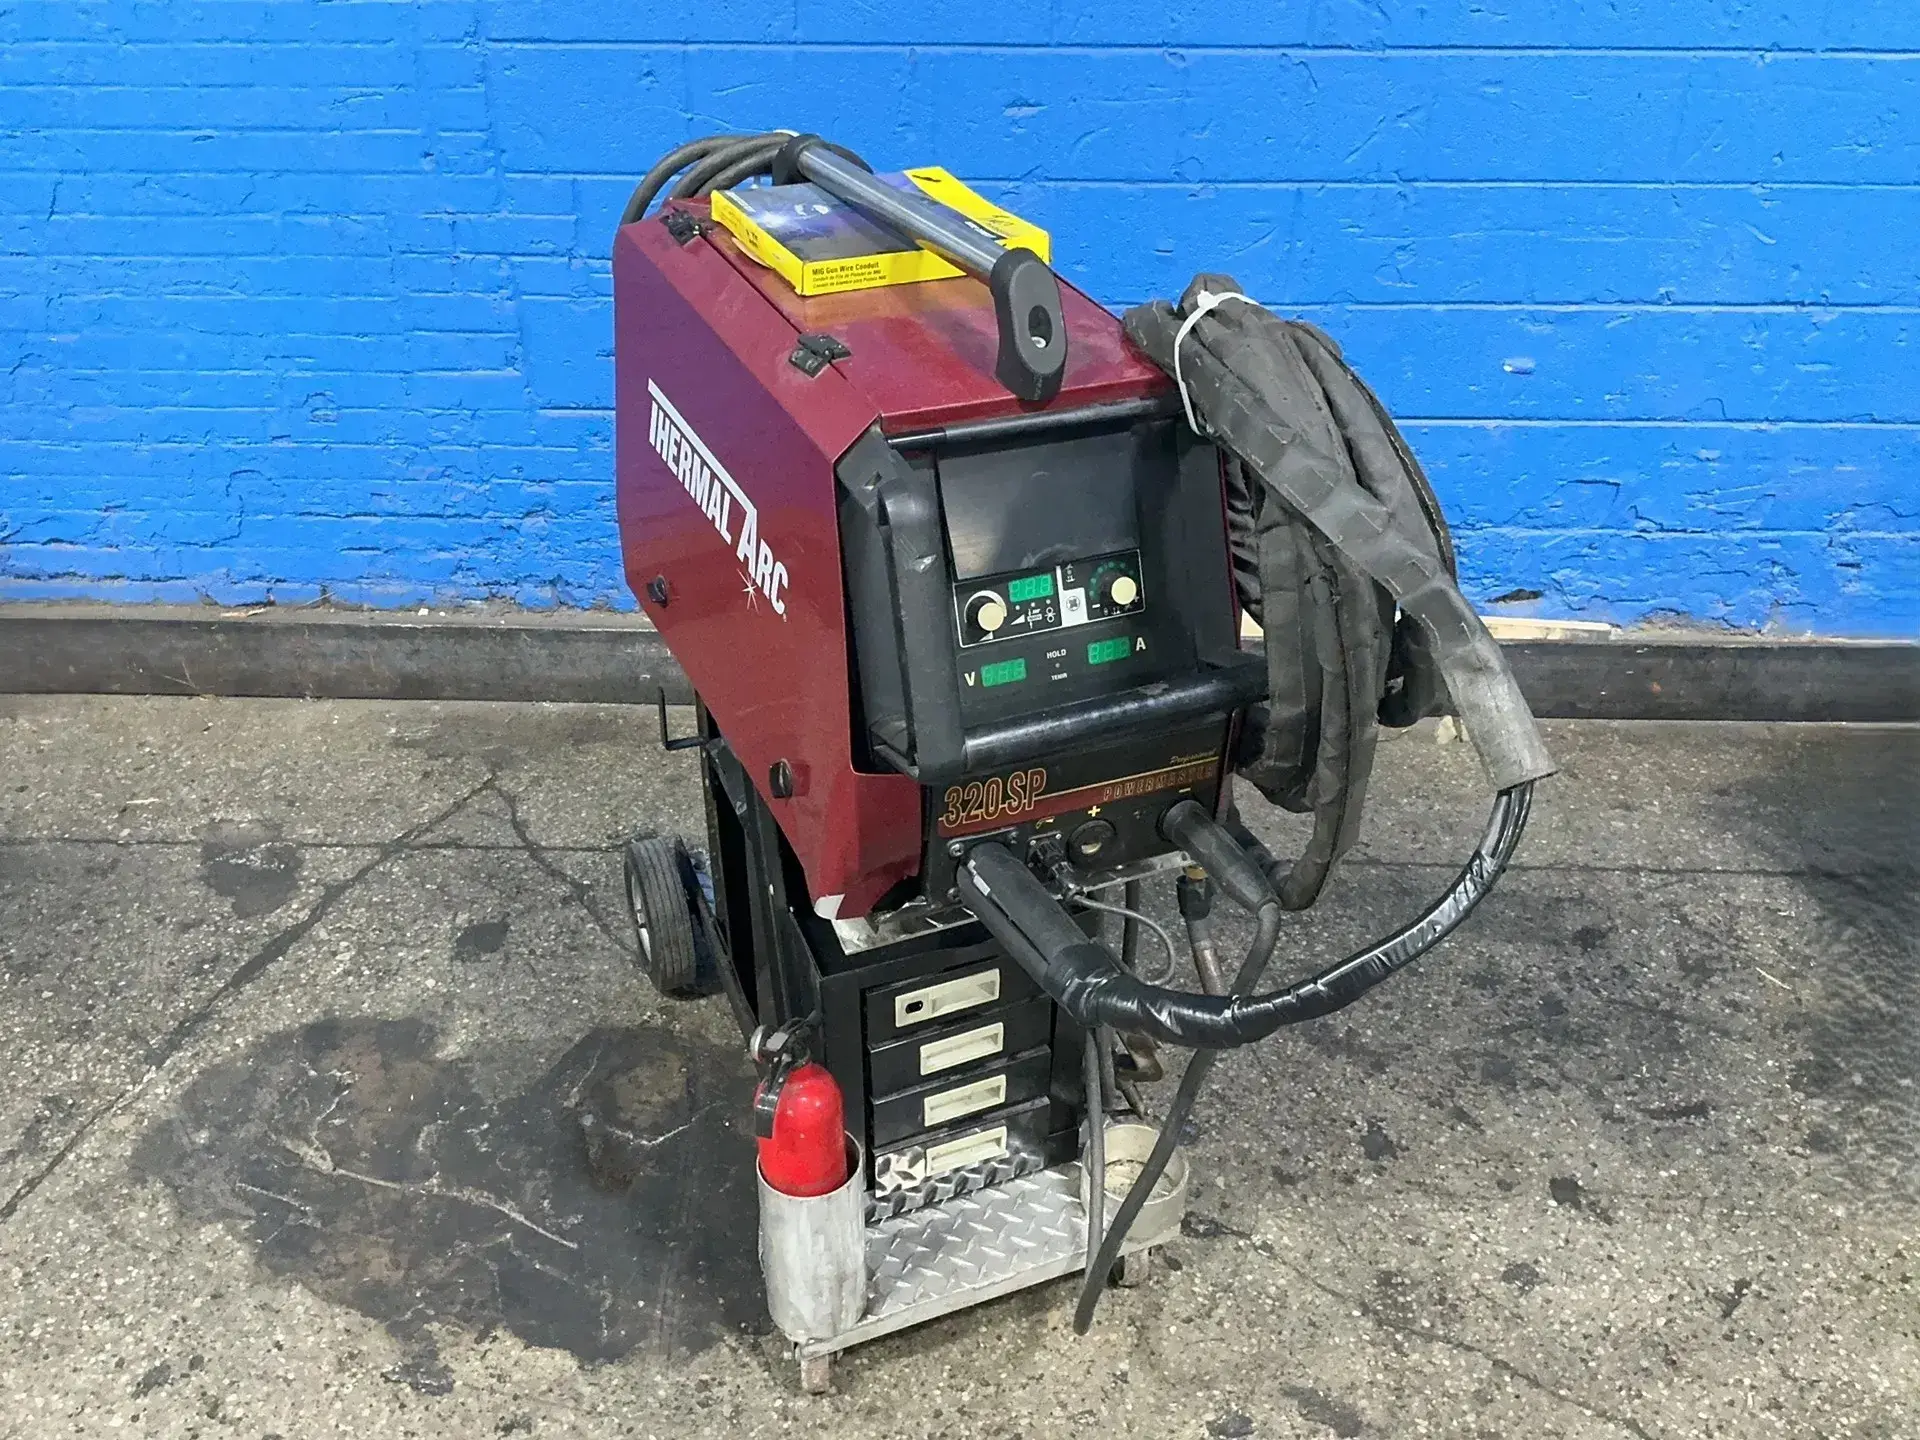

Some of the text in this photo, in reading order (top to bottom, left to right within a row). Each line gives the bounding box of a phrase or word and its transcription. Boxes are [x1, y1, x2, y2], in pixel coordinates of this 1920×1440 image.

[812, 268, 825, 276] MIG
[840, 264, 854, 272] Wire
[855, 261, 879, 271] Conduit
[648, 378, 789, 615] THERMAL ARC
[1135, 636, 1147, 651] A
[1046, 648, 1067, 659] HOLD
[964, 671, 976, 687] V
